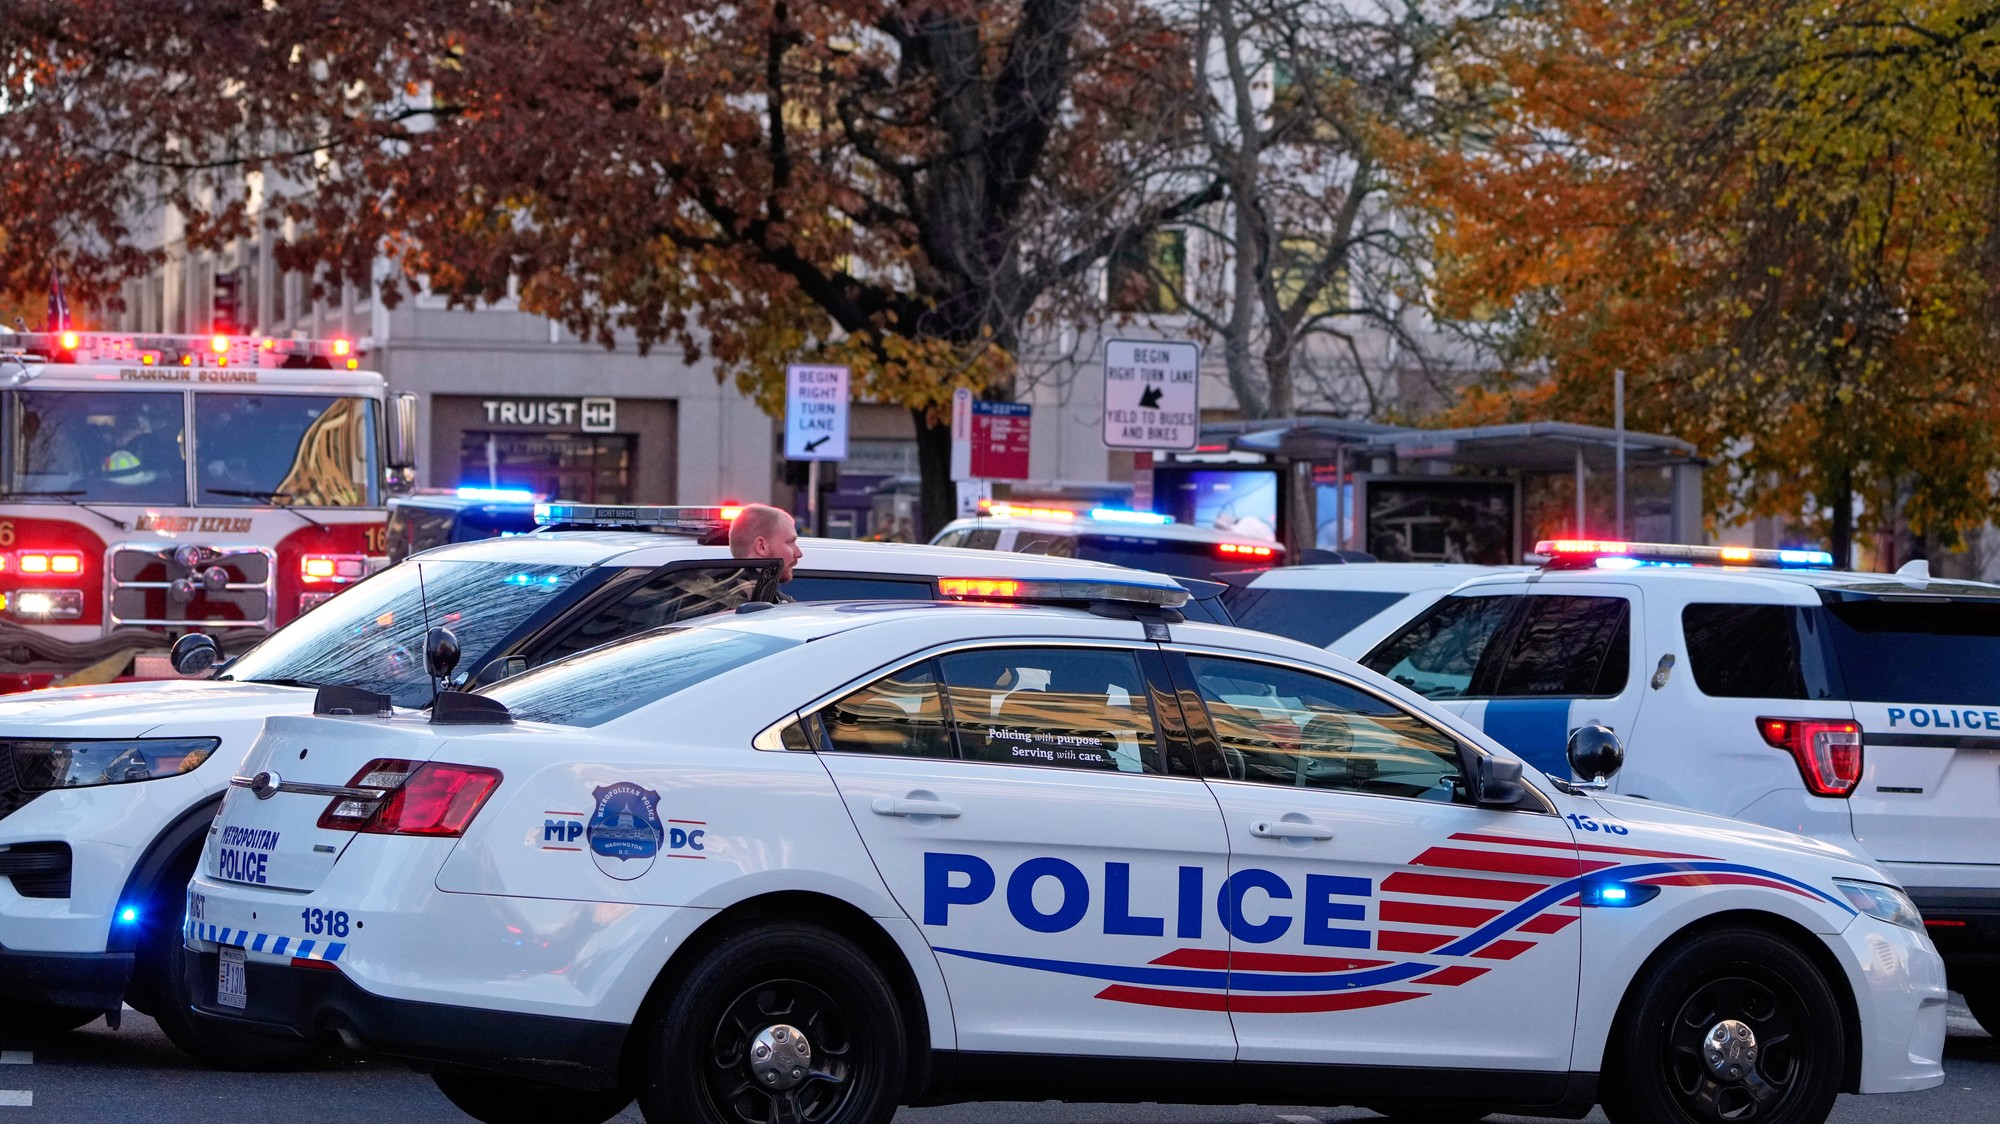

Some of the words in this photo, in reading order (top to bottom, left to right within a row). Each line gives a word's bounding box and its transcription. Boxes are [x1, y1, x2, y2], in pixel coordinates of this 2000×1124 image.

[1134, 348, 1169, 363] BEGIN
[120, 369, 190, 380] FRANKLIN
[198, 371, 257, 382] SQUARE
[798, 371, 838, 383] BEGIN
[1109, 367, 1135, 380] RIGHT
[1140, 368, 1164, 381] TURN
[1170, 370, 1194, 384] LANE
[798, 387, 837, 399] RIGHT
[483, 401, 577, 425] TRUIST
[801, 402, 835, 414] TURN
[799, 419, 834, 431] LANE
[1107, 410, 1137, 424] YIELD
[1142, 411, 1155, 424] TO
[1160, 412, 1194, 426] BUSES
[1122, 426, 1142, 439] AND
[1147, 427, 1178, 441] BIKES
[597, 509, 616, 518] SECRET
[616, 509, 635, 518] SERVICE
[365, 527, 386, 551] 16
[1887, 707, 2000, 731] POLICE
[988, 728, 1031, 743] Policing
[1034, 732, 1054, 743] with
[1057, 735, 1103, 747] purpose.
[1012, 746, 1053, 760] Serving
[1056, 750, 1076, 760] with
[1078, 752, 1104, 762] care.
[597, 787, 640, 818] METROPOLITAN
[641, 796, 655, 821] POLICE
[220, 825, 280, 851] METROPOLITAN
[544, 819, 583, 842] MP
[669, 828, 705, 851] DC
[604, 842, 643, 851] WASHINGTON
[220, 848, 268, 884] POLICE
[924, 852, 1372, 949] POLICE
[301, 907, 350, 938] 1318
